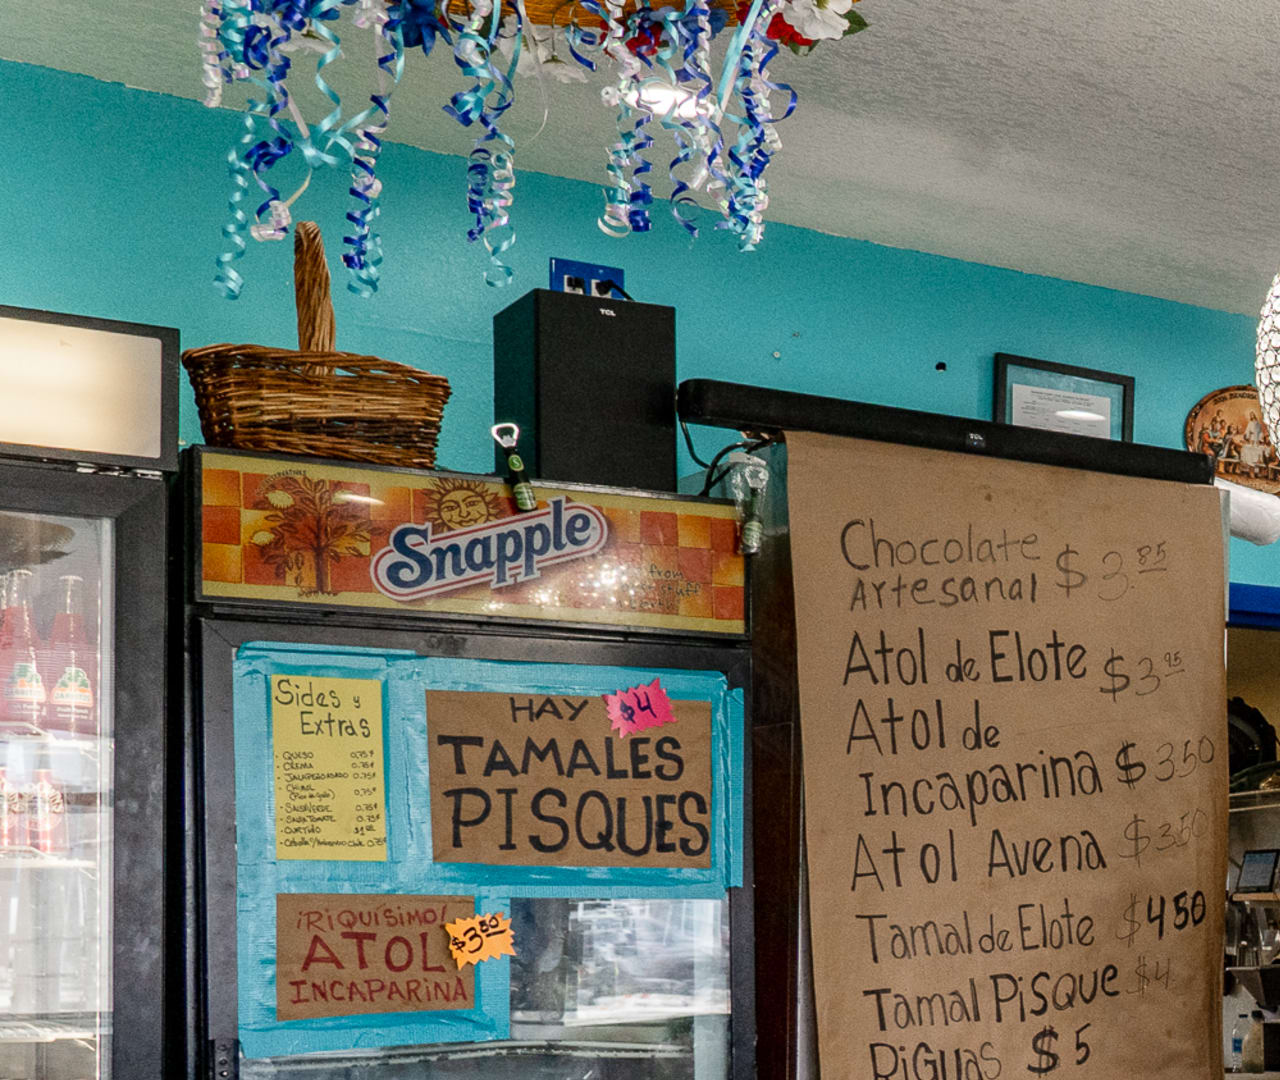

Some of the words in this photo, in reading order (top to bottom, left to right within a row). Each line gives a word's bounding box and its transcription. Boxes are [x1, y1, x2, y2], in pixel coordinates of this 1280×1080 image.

[599, 308, 616, 317] TCL
[384, 499, 591, 584] Snapple
[841, 519, 1041, 570] Chocolate
[648, 563, 684, 580] from
[850, 574, 1037, 611] Artesanal
[843, 628, 928, 686] Atol
[946, 640, 980, 682] de
[989, 630, 1087, 683] Elote
[275, 679, 341, 709] Sides
[353, 696, 361, 709] y
[509, 697, 588, 723] HAY
[620, 692, 657, 724] $4
[300, 711, 371, 738] Extras
[847, 698, 946, 755] Atol
[962, 699, 1000, 750] de
[437, 735, 684, 781] TAMALES
[859, 750, 1103, 826] Incaparina
[443, 787, 710, 856] PISQUES
[851, 829, 957, 891] Atol
[988, 829, 1107, 879] Avena
[301, 931, 446, 973] ATOL
[855, 911, 973, 964] Tamal
[979, 923, 1013, 953] de
[1018, 898, 1095, 951] Elote
[863, 978, 981, 1031] Tamal
[1027, 1023, 1092, 1079] $5
